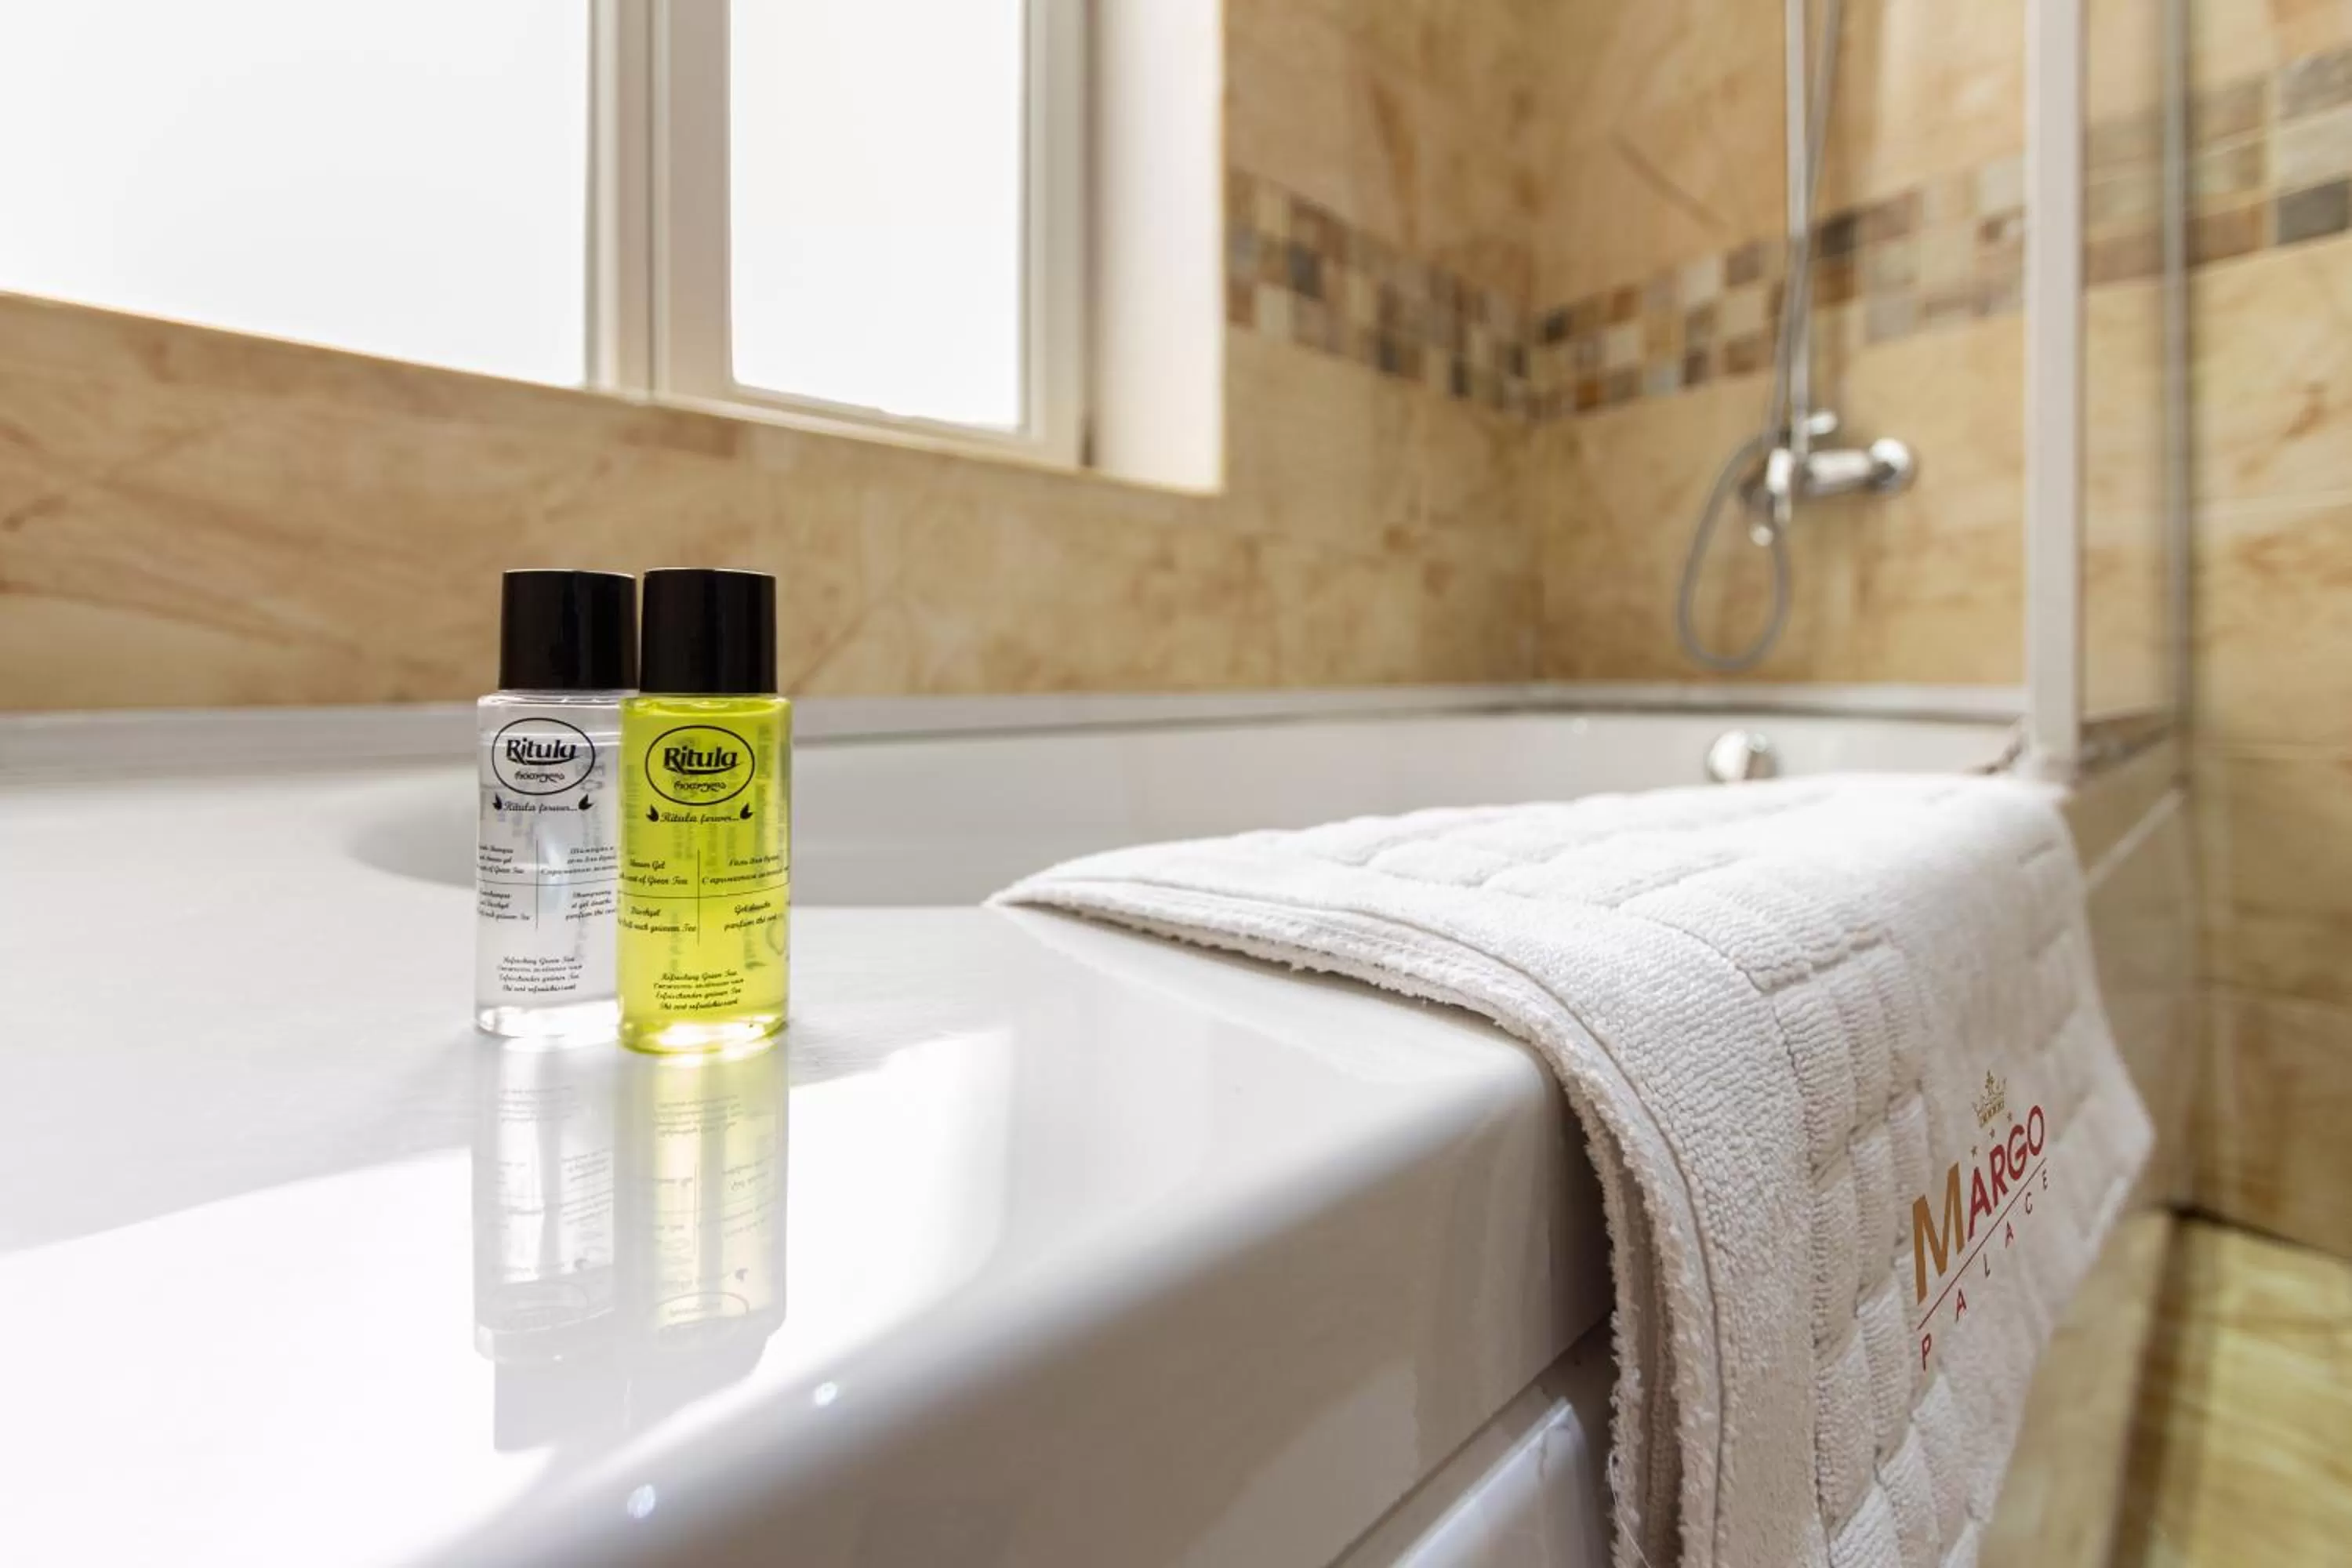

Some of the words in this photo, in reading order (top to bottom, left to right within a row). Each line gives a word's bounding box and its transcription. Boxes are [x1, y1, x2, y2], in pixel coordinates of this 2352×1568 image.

[506, 737, 578, 765] Ritula
[664, 746, 739, 775] Ritula
[1912, 1105, 2045, 1306] MARGO
[1920, 1169, 2050, 1371] PALACE
